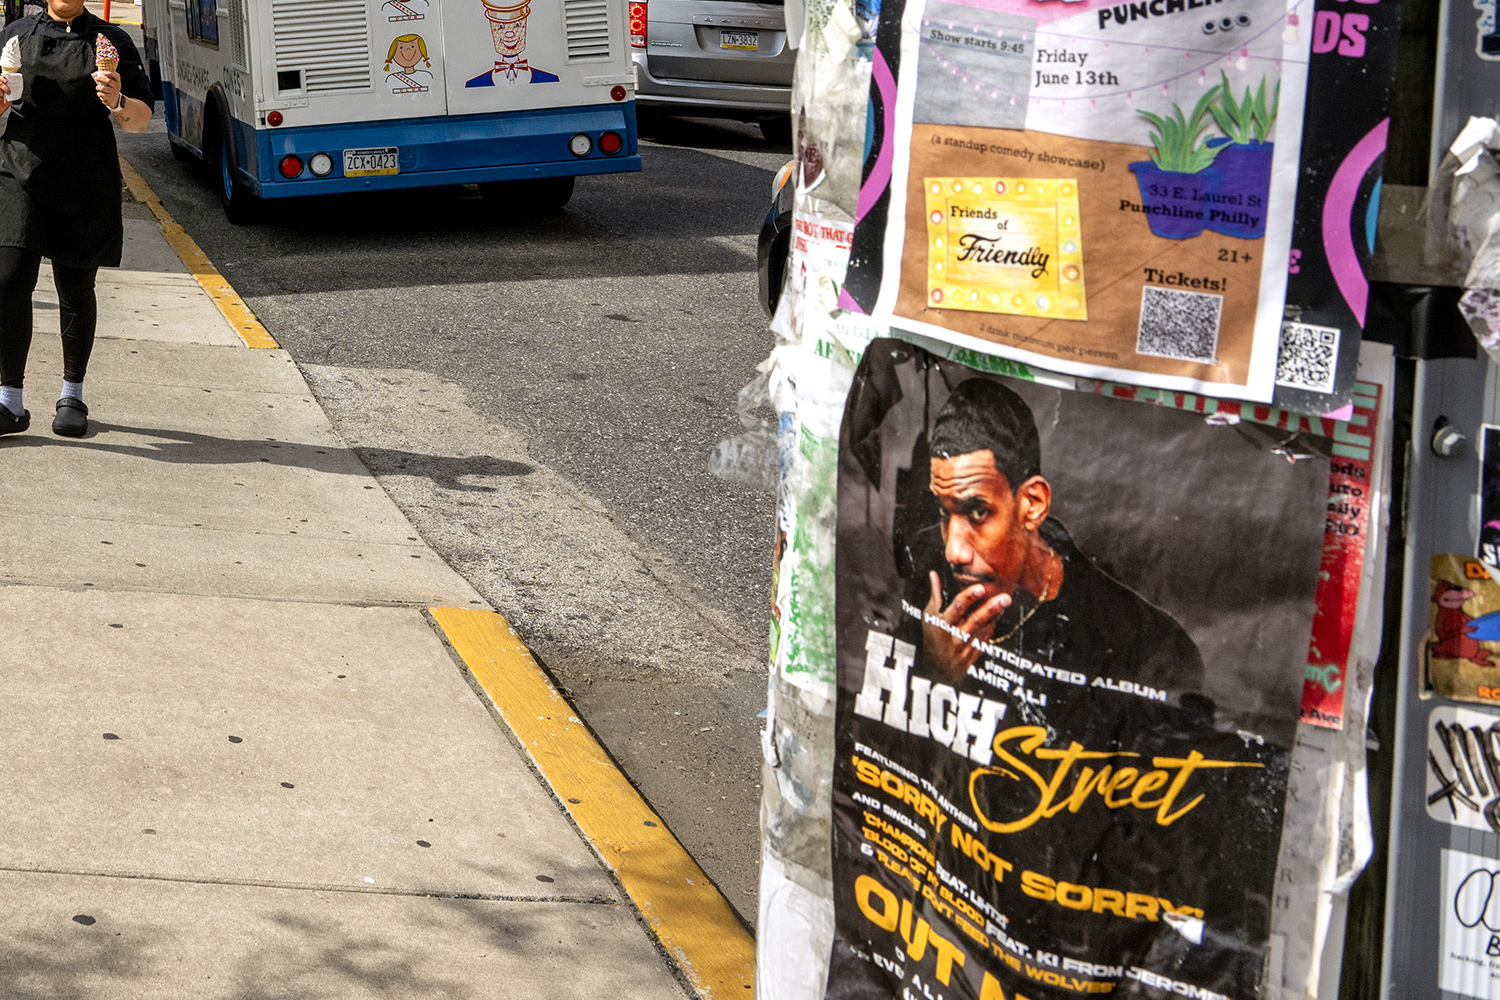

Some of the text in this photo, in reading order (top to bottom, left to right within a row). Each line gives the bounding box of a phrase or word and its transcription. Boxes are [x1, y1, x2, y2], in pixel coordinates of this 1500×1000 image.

[930, 29, 1025, 55] Show starts 9:45
[1036, 49, 1088, 67] Friday
[1034, 70, 1120, 87] June 13th
[943, 135, 988, 155] standup
[989, 143, 1035, 163] comedy
[1036, 150, 1106, 173] showcase)
[950, 205, 998, 221] Friends
[1118, 199, 1261, 228] Punchline Philly
[1149, 184, 1170, 199] 33
[1191, 187, 1244, 207] Laurel
[1246, 192, 1263, 206] St
[997, 219, 1009, 231] of
[956, 233, 1051, 279] Friendly
[1217, 248, 1254, 264] 21+
[1143, 268, 1228, 293] Tickets!
[1057, 341, 1077, 356] per
[1078, 345, 1119, 361] person
[901, 599, 1167, 701] THE HIGHLY ANTICIPATED ALBUM
[966, 664, 1048, 707] AMIR ALI
[985, 659, 1025, 687] FROM
[853, 629, 1008, 766] HIGH
[854, 741, 920, 785] FEATURING
[938, 795, 979, 833] ANTHEM
[968, 725, 1266, 834] Street
[852, 791, 927, 840] AND SINGLES
[951, 823, 1013, 883] NOT
[854, 873, 966, 988] OUT
[909, 856, 927, 877] OF
[939, 885, 985, 928] BLOOD
[985, 918, 1034, 961] FEAT.
[1036, 949, 1059, 968] KI
[1062, 956, 1123, 978] FROM
[955, 915, 990, 949] FEED
[991, 941, 1022, 973] THE
